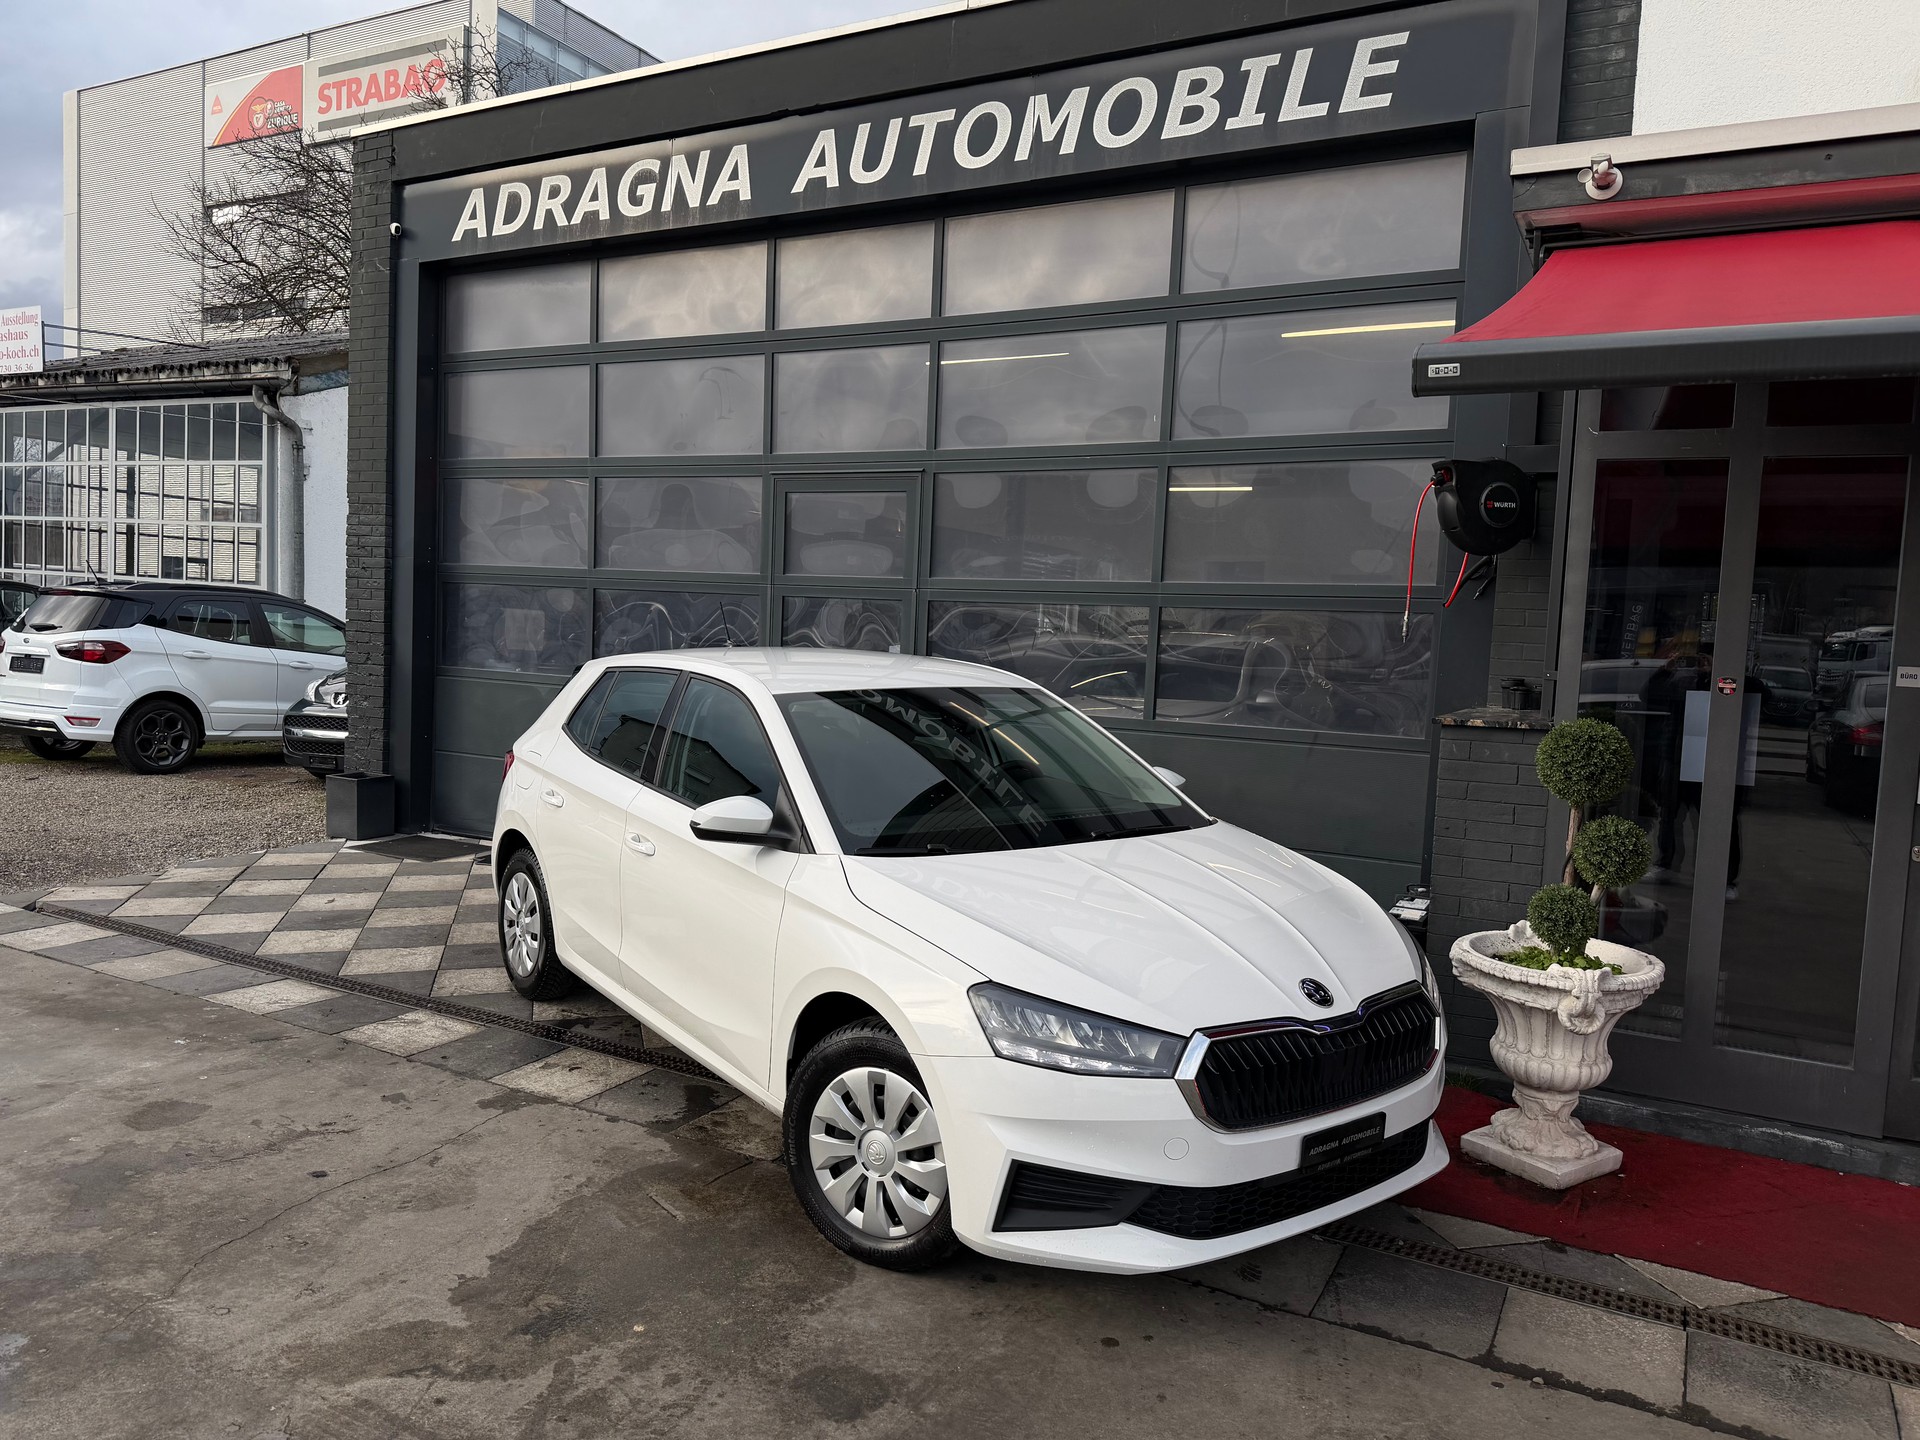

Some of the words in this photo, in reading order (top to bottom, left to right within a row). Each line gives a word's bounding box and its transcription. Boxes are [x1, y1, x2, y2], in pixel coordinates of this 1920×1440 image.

[317, 58, 447, 115] STRABAG
[451, 143, 752, 242] ADRAGNA
[790, 31, 1411, 193] AUTOMOBILE
[1, 312, 38, 327] Ausstellung
[14, 364, 22, 372] 36
[25, 363, 33, 371] 36
[1899, 672, 1918, 680] BÜRO
[1308, 1139, 1340, 1156] ADRAGNA
[1341, 1126, 1381, 1146] AUTOMOBILE
